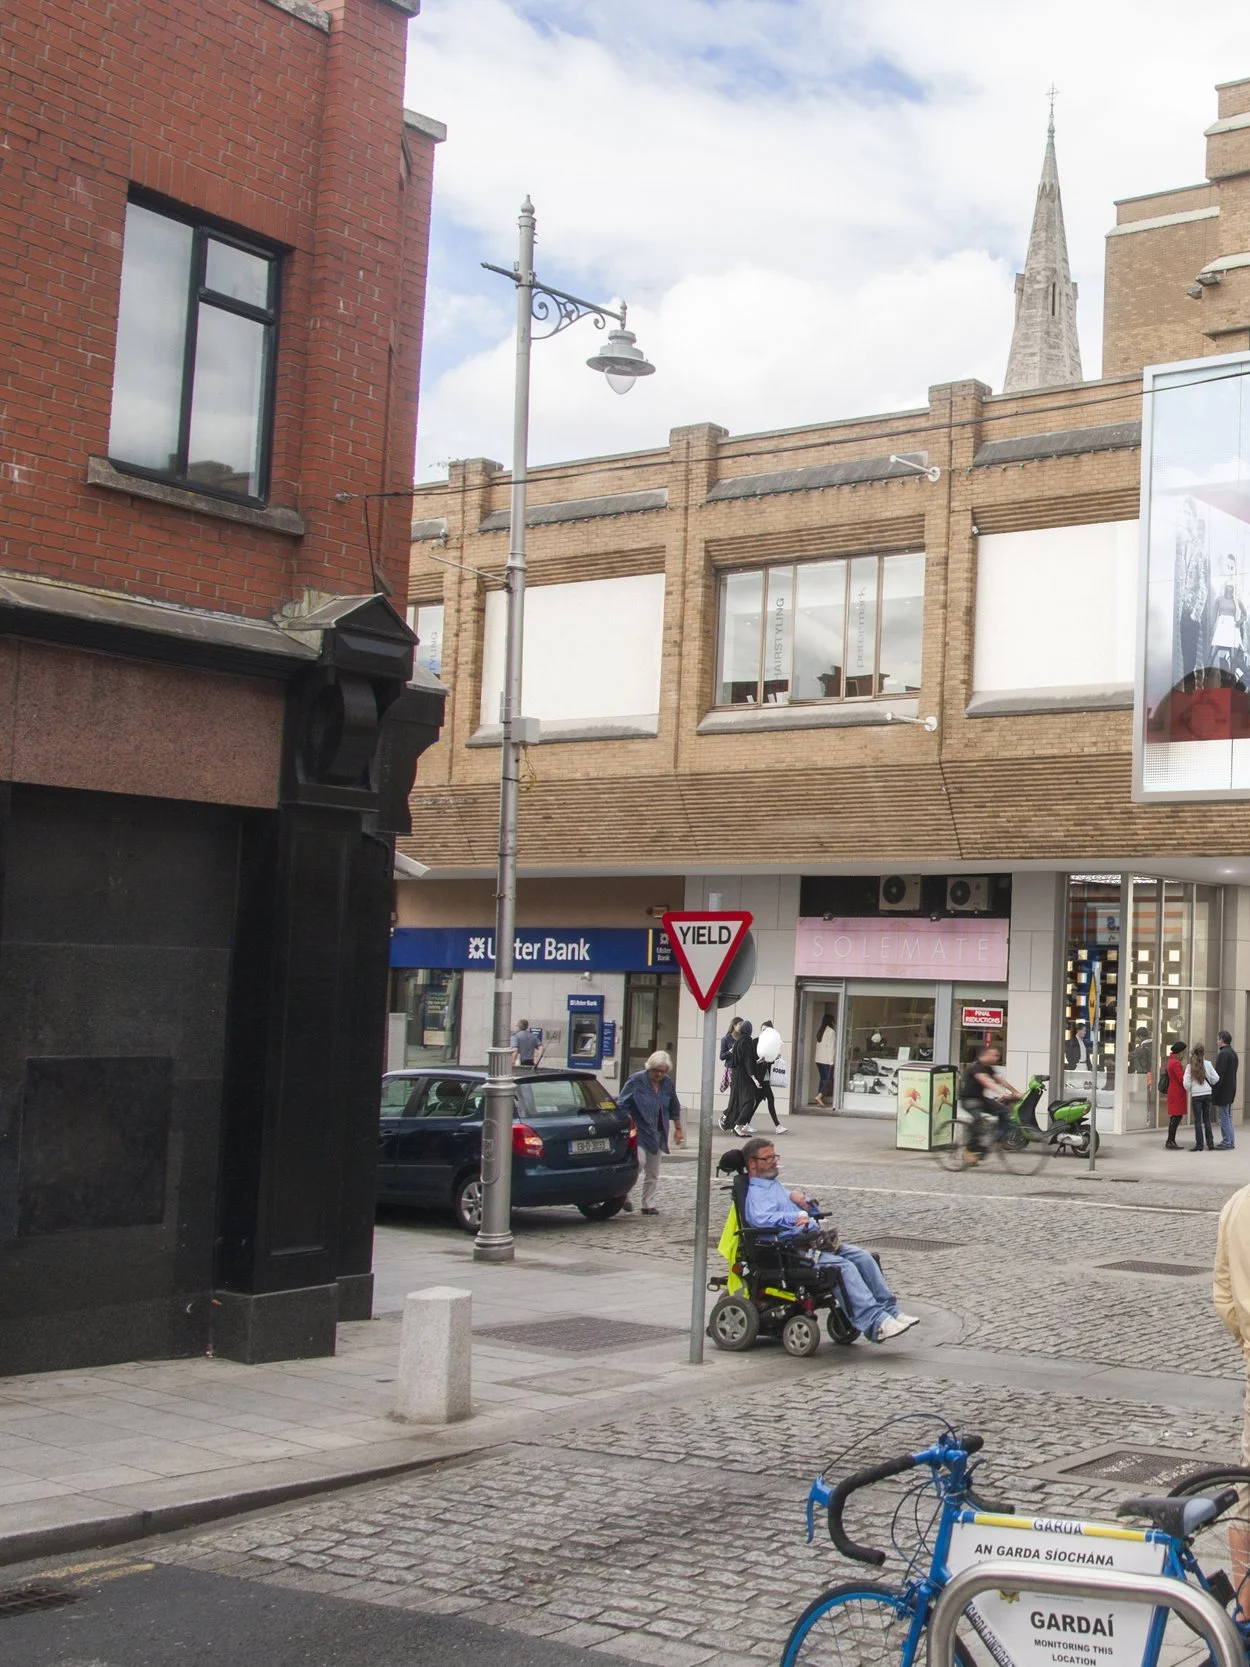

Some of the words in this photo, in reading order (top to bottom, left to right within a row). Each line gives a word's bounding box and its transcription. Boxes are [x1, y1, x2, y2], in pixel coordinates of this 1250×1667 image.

[773, 597, 785, 681] HAIRSTYLING
[678, 925, 732, 946] YIELD
[487, 937, 541, 960] Uter
[544, 937, 590, 961] Bank
[812, 935, 990, 961] SOLEMATE
[965, 1016, 1001, 1024] REDUCTIONS
[1032, 1518, 1084, 1536] GARDA
[974, 1543, 993, 1555] AN
[996, 1546, 1041, 1560] GARDA
[1044, 1547, 1115, 1567] SÍOCHÁNA
[966, 1605, 988, 1634] GARDA
[1030, 1611, 1115, 1637] GARDAÍ
[1033, 1638, 1090, 1653] MONITORING
[1092, 1644, 1115, 1656] THIS
[1051, 1653, 1097, 1667] LOCATION
